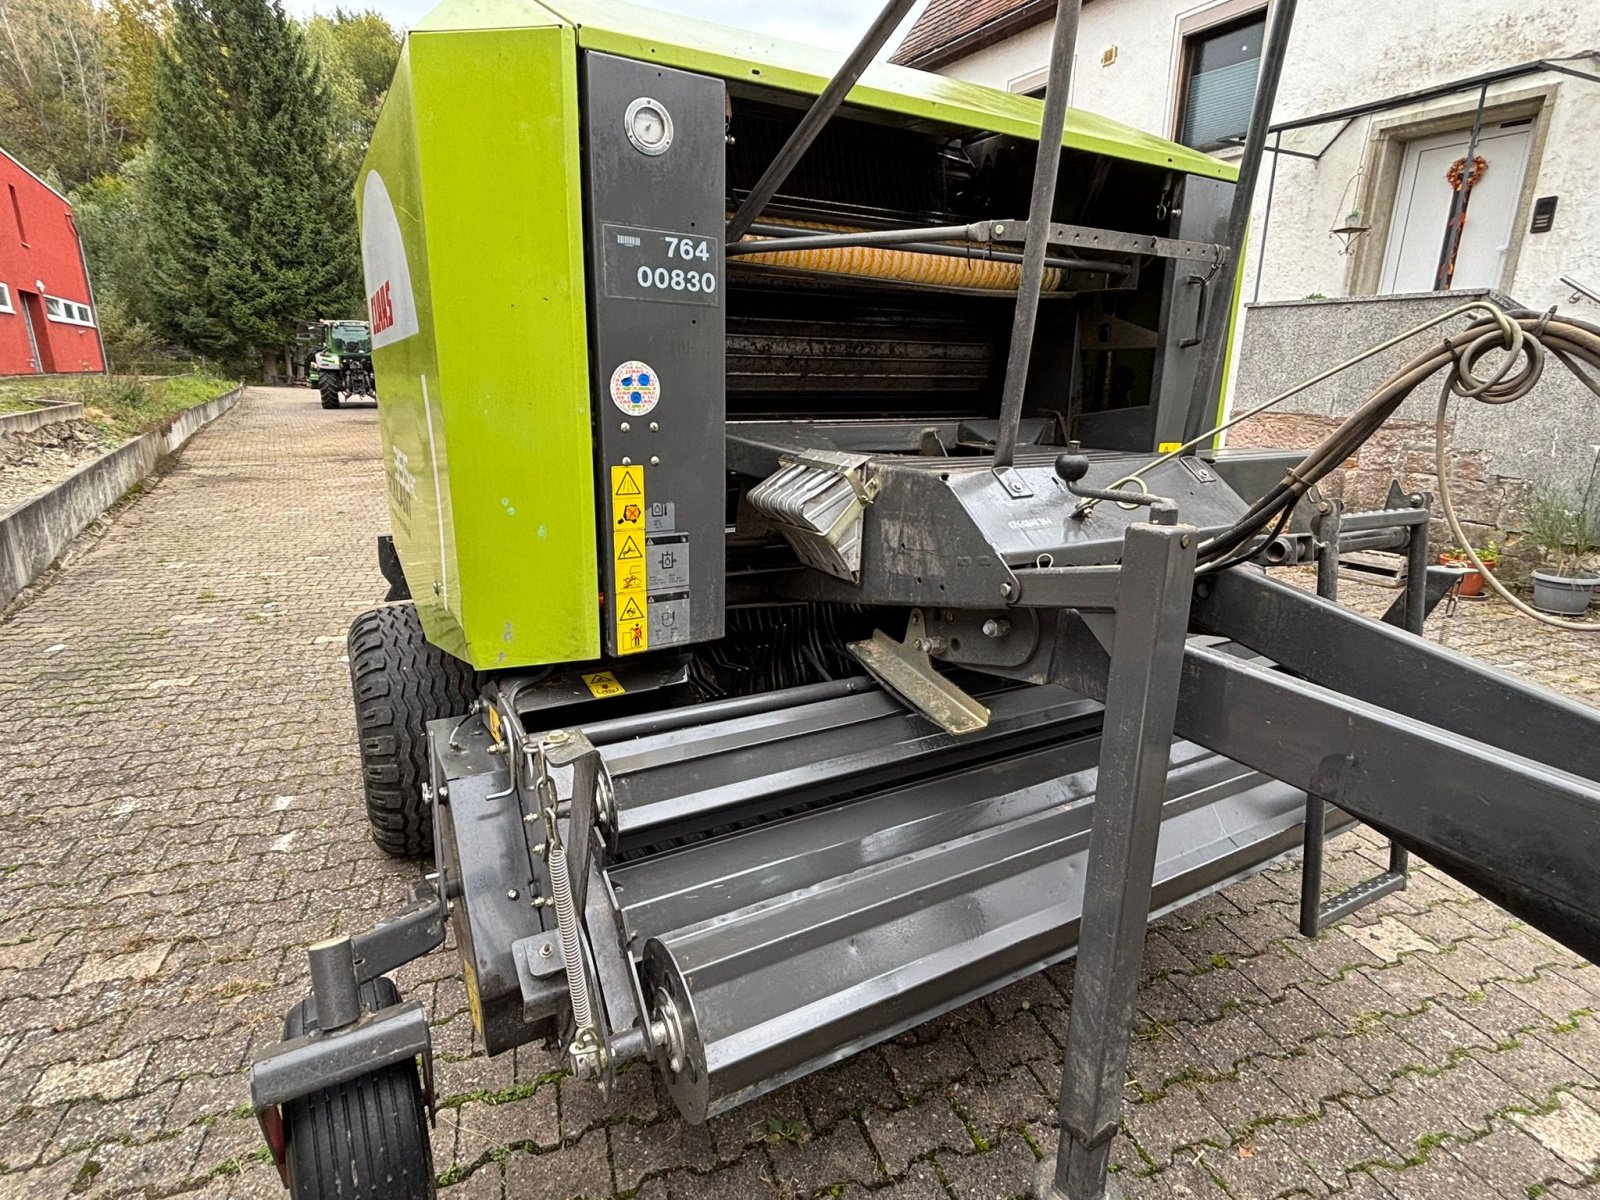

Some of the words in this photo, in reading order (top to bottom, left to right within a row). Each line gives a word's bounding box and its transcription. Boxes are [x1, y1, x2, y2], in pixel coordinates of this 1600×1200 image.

[664, 236, 710, 262] 764
[637, 265, 716, 293] 00830
[370, 279, 394, 335] CLAAS
